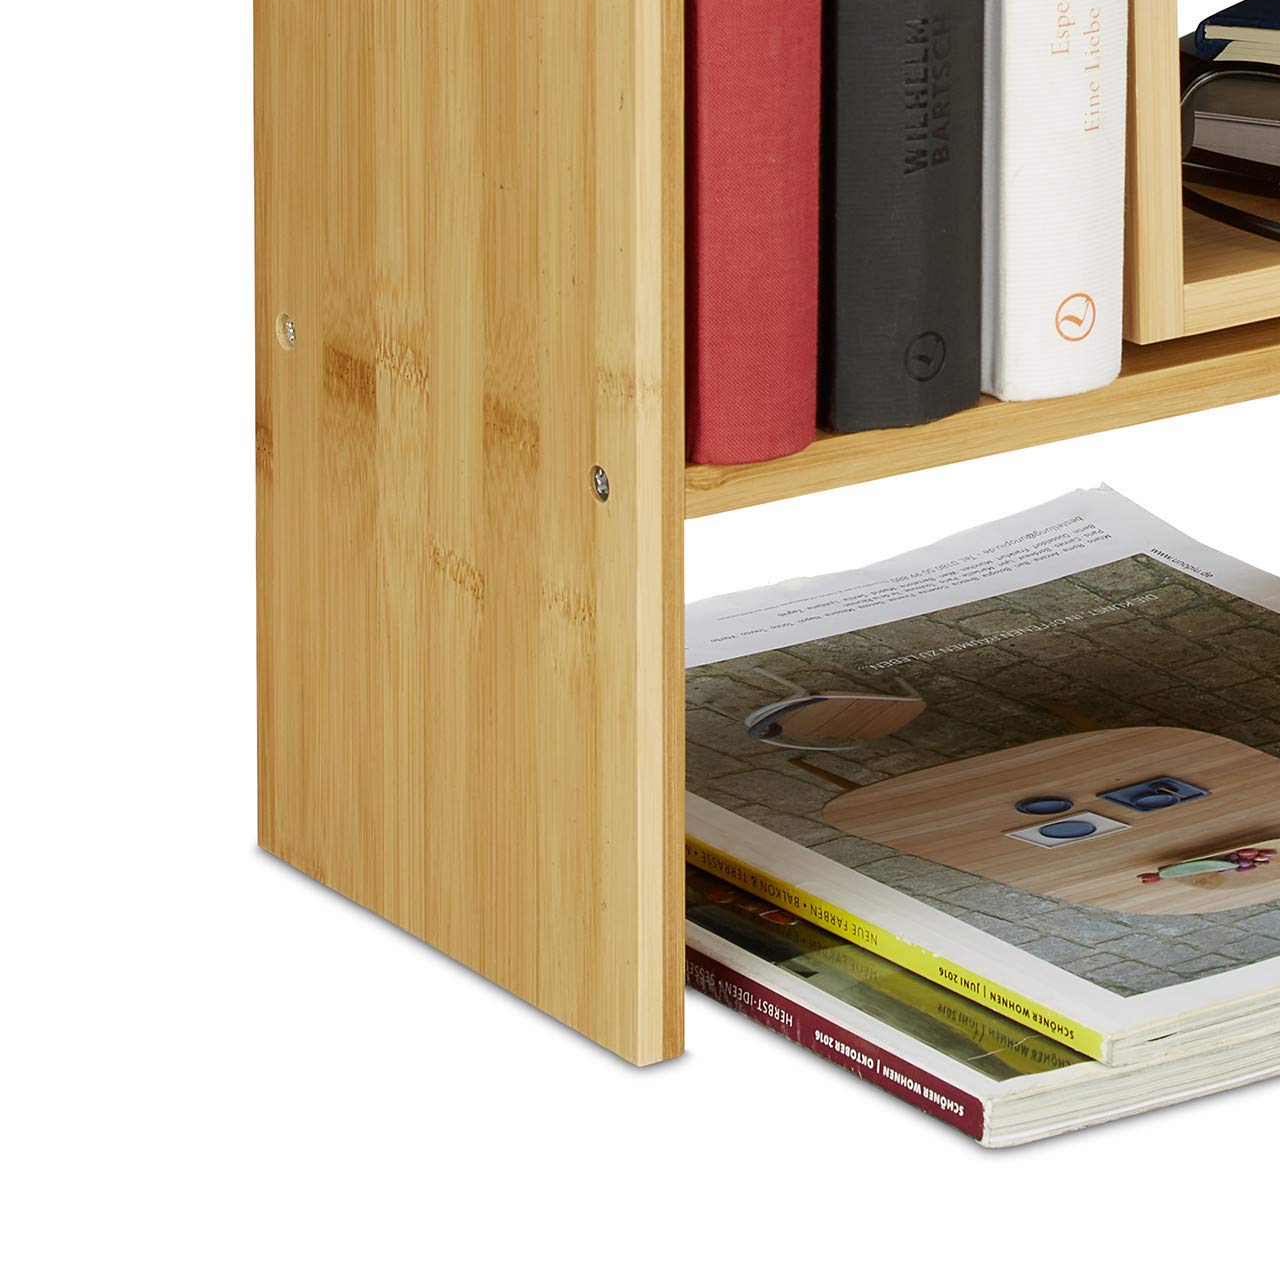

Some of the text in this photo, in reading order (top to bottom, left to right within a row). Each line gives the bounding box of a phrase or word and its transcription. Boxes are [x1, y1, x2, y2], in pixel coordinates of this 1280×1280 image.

[1083, 6, 1102, 72] Liebe
[931, 16, 952, 166] BARTSCH
[1084, 80, 1101, 135] Eine
[1137, 593, 1159, 604] DIE
[918, 649, 940, 659] ZU
[701, 851, 878, 946] NEUE FARBEN BALKON & TERRASSE
[724, 981, 793, 1027] HERBST-IDEEN
[938, 967, 1075, 1040] SCHÖNER WOHNEN JUNI 2016
[814, 1029, 965, 1117] SCHÖNER WOHNEN OKTOBER 2016
